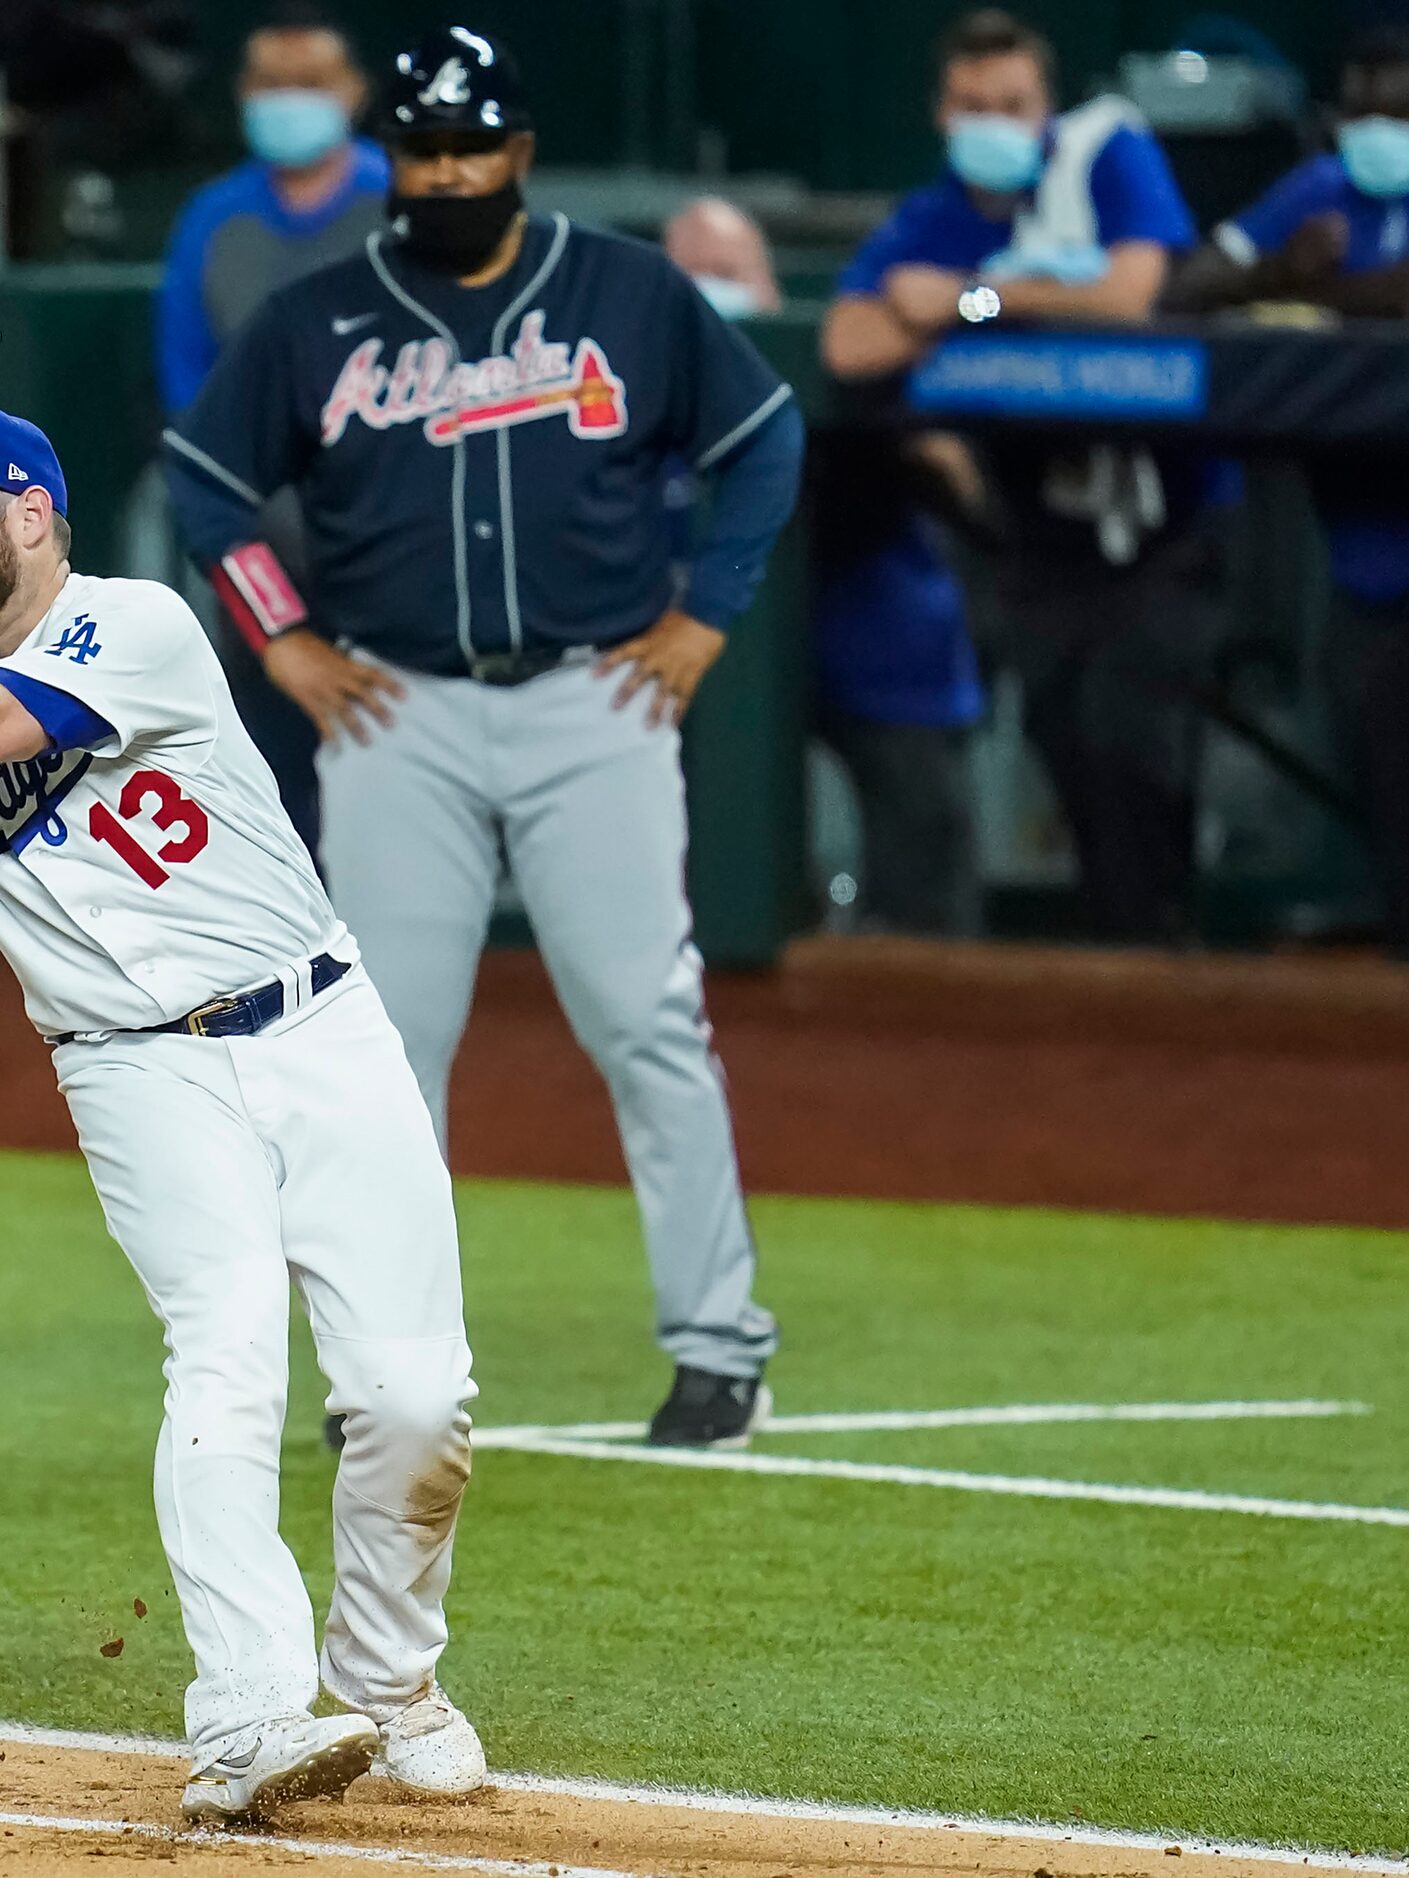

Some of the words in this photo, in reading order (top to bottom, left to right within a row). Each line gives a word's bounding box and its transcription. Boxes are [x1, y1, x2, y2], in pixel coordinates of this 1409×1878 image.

[321, 309, 572, 446] Atlanta
[44, 613, 102, 665] LA
[88, 769, 209, 891] 13
